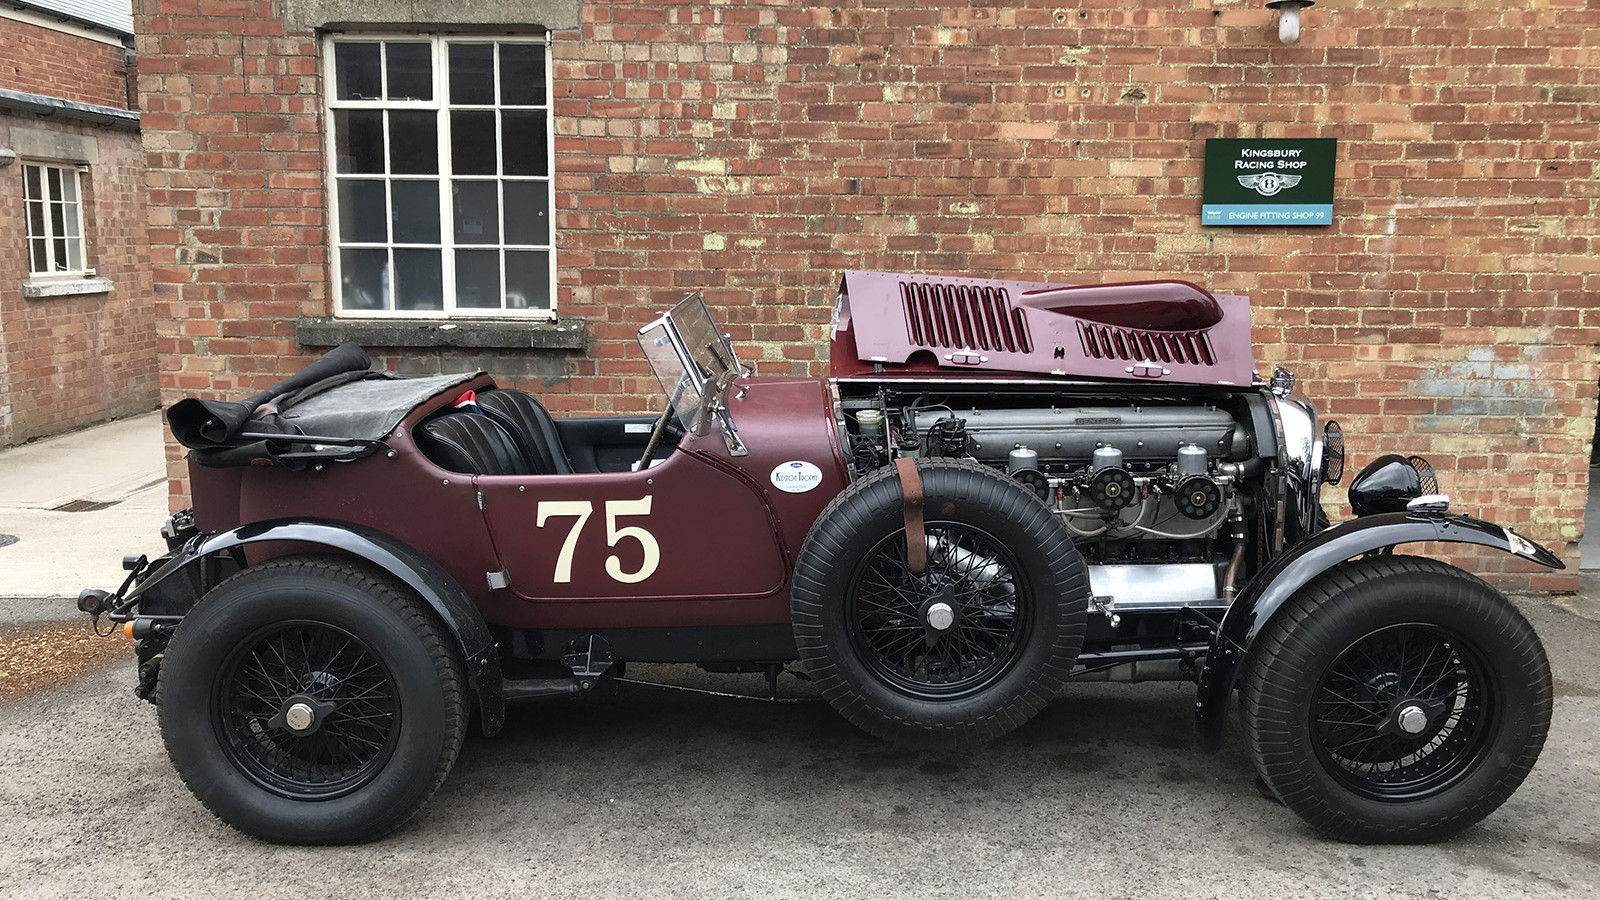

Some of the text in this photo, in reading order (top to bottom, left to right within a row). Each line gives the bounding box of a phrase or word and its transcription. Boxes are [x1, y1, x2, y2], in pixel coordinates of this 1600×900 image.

[1241, 148, 1302, 158] KINGSBURY
[1234, 160, 1307, 169] RACING SHOP
[1228, 211, 1258, 220] ENGINE
[1259, 211, 1291, 220] FITTING
[1292, 211, 1314, 220] SHOP
[1315, 211, 1325, 219] 99
[536, 495, 660, 584] 75
